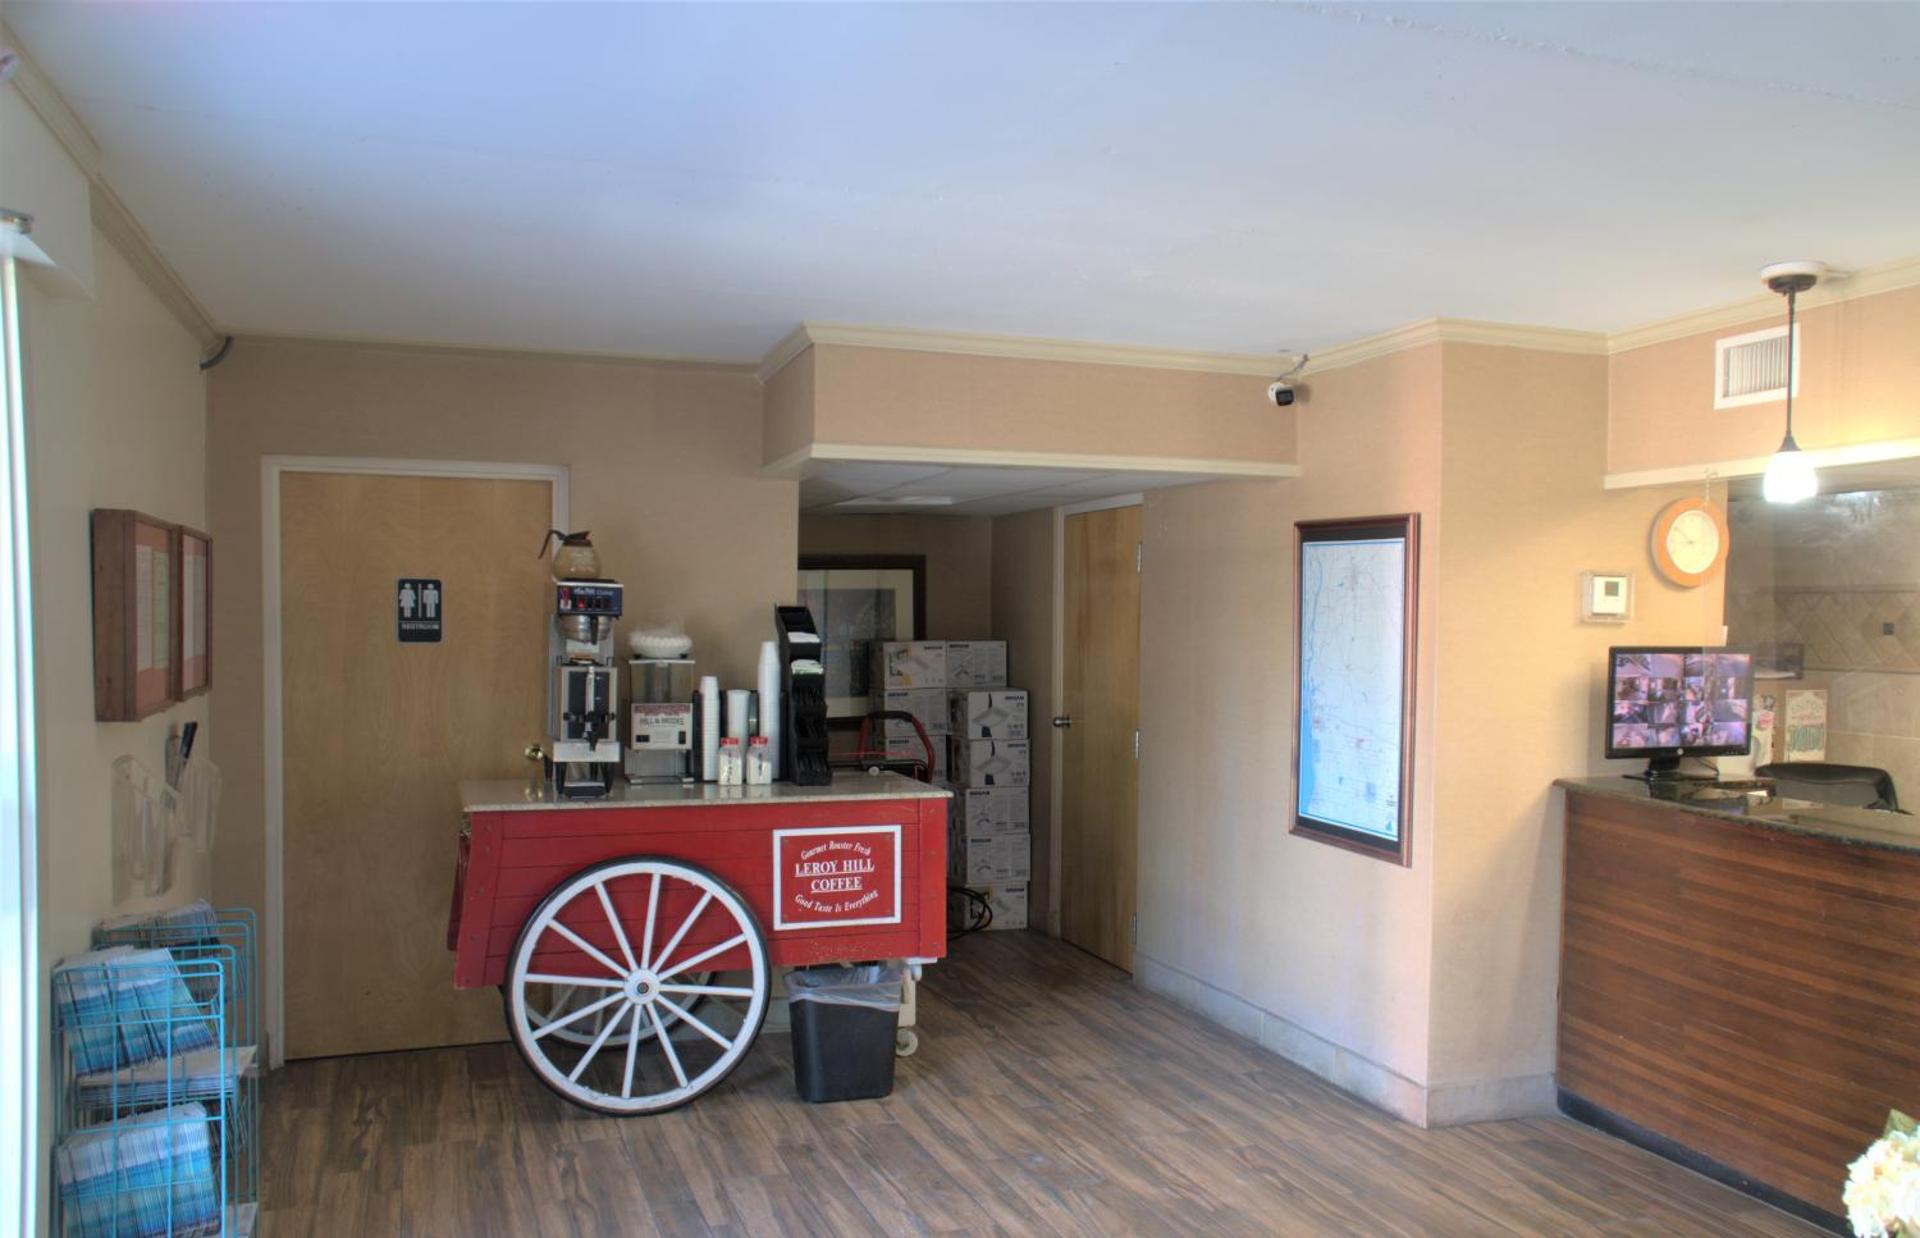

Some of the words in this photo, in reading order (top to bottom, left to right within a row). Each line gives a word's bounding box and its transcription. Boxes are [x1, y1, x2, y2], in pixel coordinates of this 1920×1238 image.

[801, 844, 827, 860] Gourmet
[854, 842, 871, 856] Fresh
[795, 860, 838, 877] LEROY
[843, 858, 875, 873] HILL
[811, 877, 863, 891] COFFEE
[795, 894, 814, 909] Good
[814, 901, 833, 912] Taste
[844, 890, 879, 911] Everything
